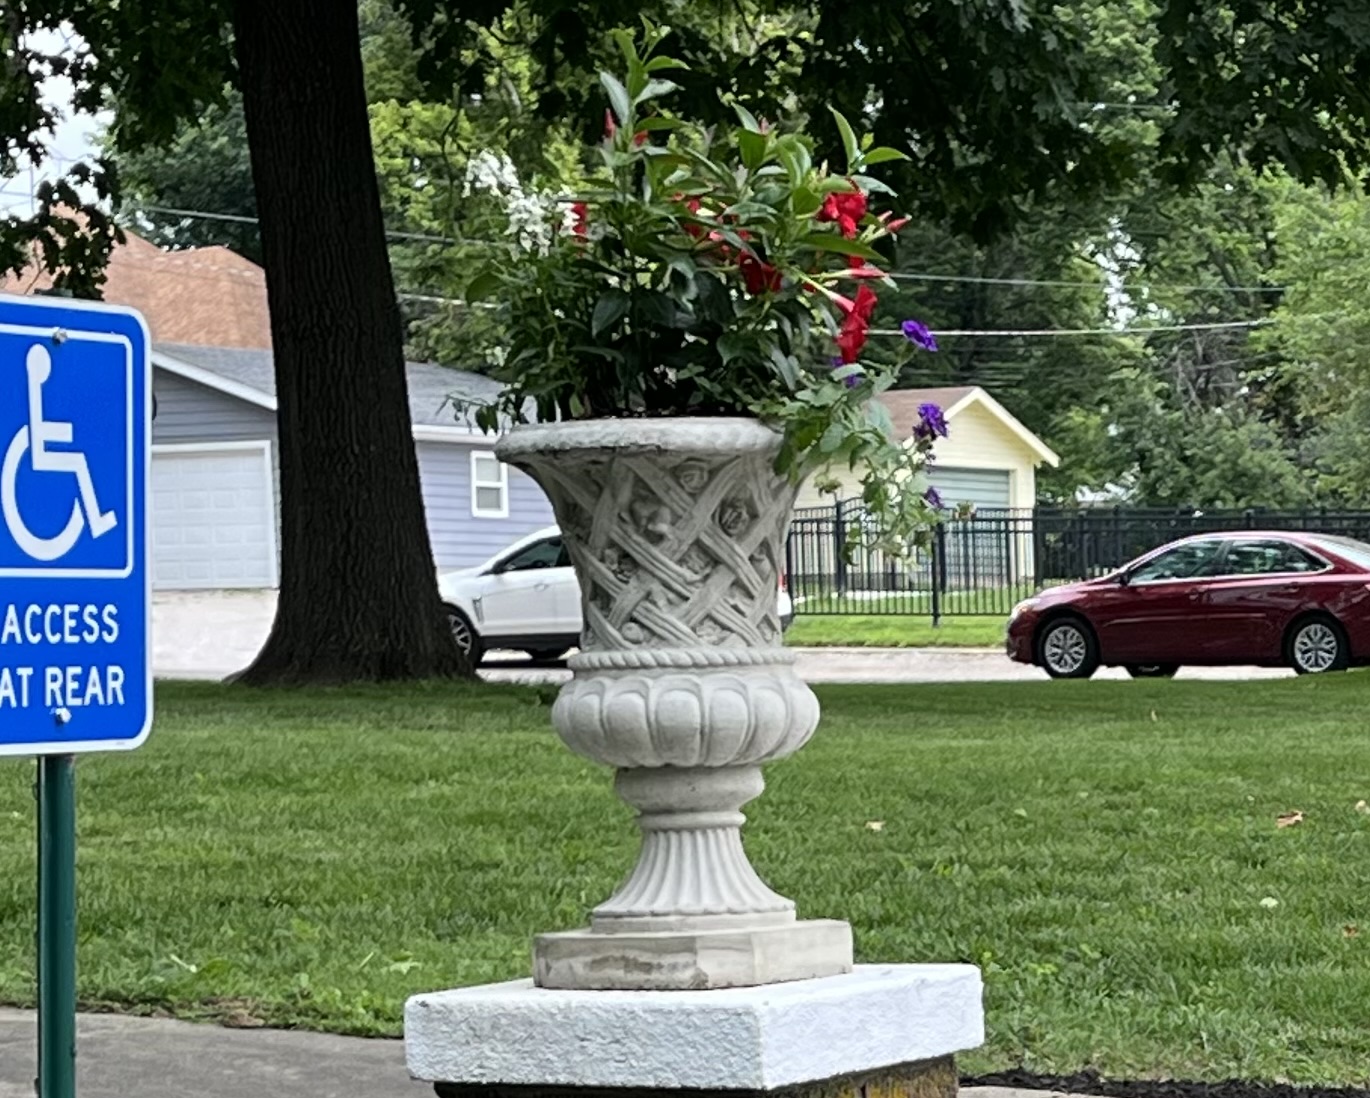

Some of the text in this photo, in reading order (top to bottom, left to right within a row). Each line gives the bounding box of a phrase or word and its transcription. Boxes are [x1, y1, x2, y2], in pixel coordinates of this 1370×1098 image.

[1, 603, 119, 644] ACCESS
[0, 665, 125, 708] AT REAR
